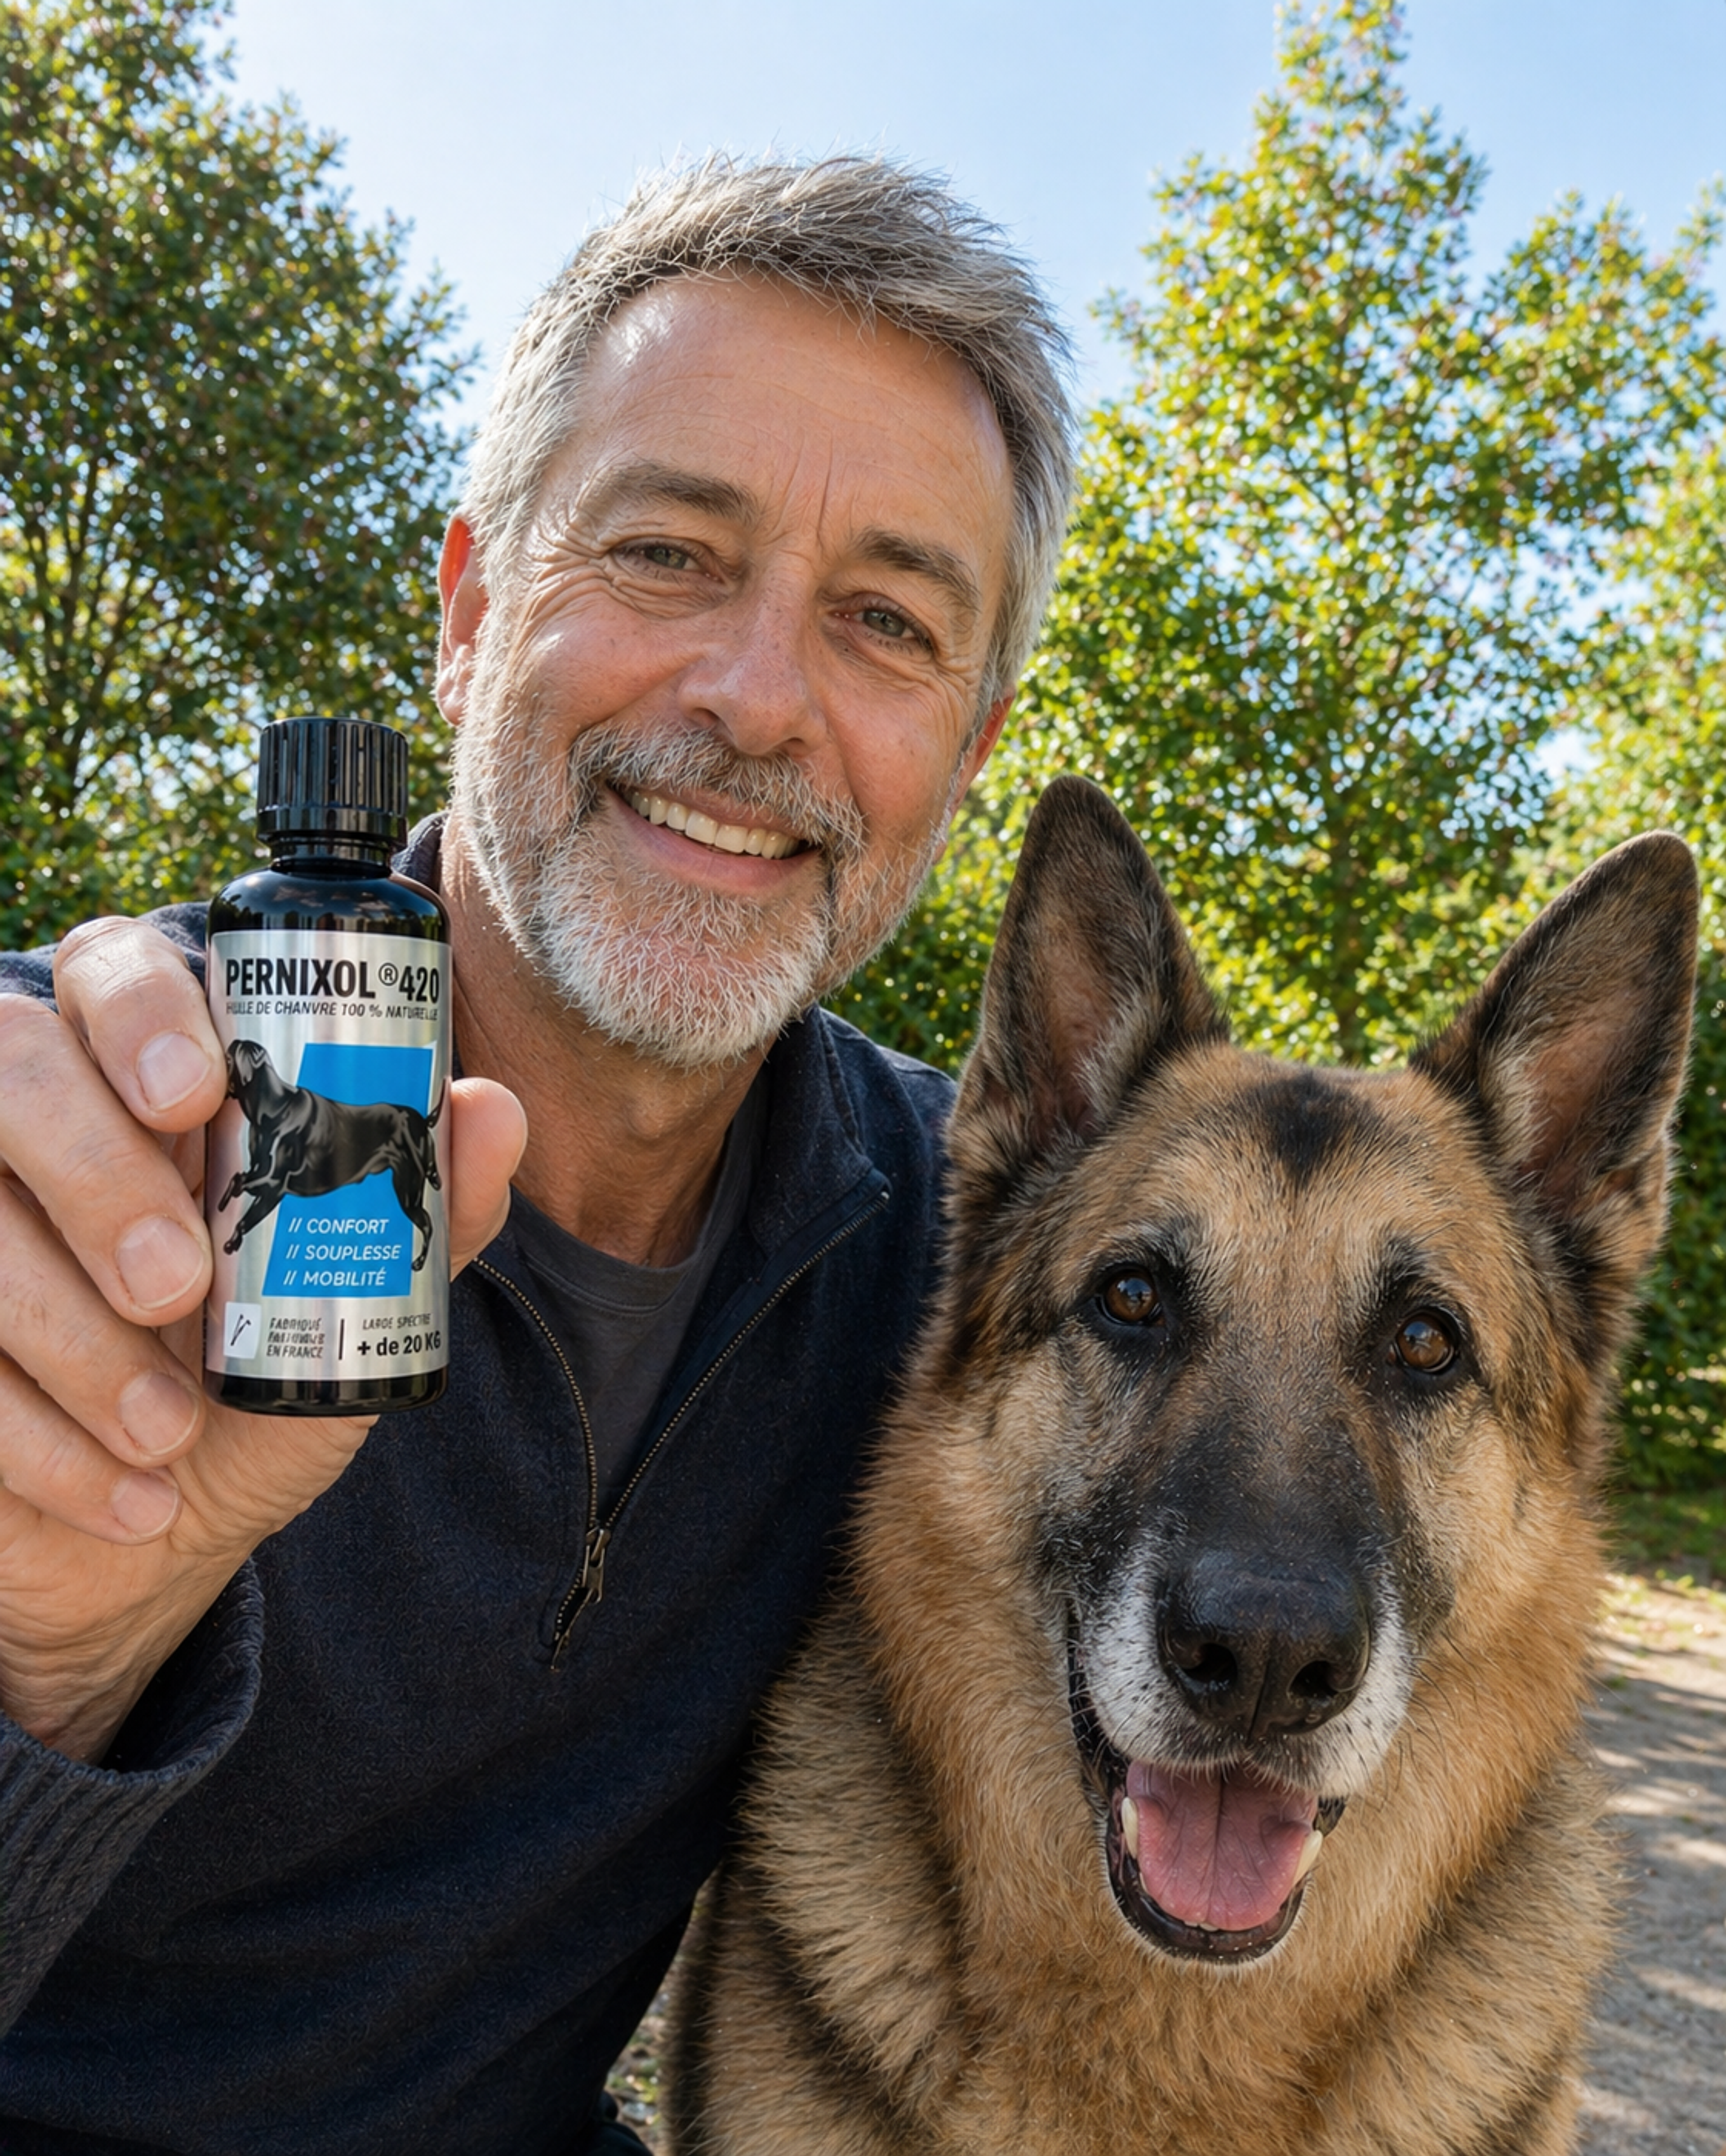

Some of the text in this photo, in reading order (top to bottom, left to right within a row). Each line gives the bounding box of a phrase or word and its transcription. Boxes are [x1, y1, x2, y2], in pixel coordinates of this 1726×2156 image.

[226, 958, 376, 999] PERNIXOL
[256, 1001, 271, 1015] DE
[275, 1001, 337, 1016] CHANVRE
[342, 1003, 365, 1017] 100
[369, 1004, 383, 1017] %
[306, 1218, 389, 1234] CONFORT
[304, 1244, 402, 1260] SOUPLESSE
[302, 1266, 387, 1287] MOBILITÉ
[376, 1336, 399, 1357] de
[403, 1334, 423, 1354] 20
